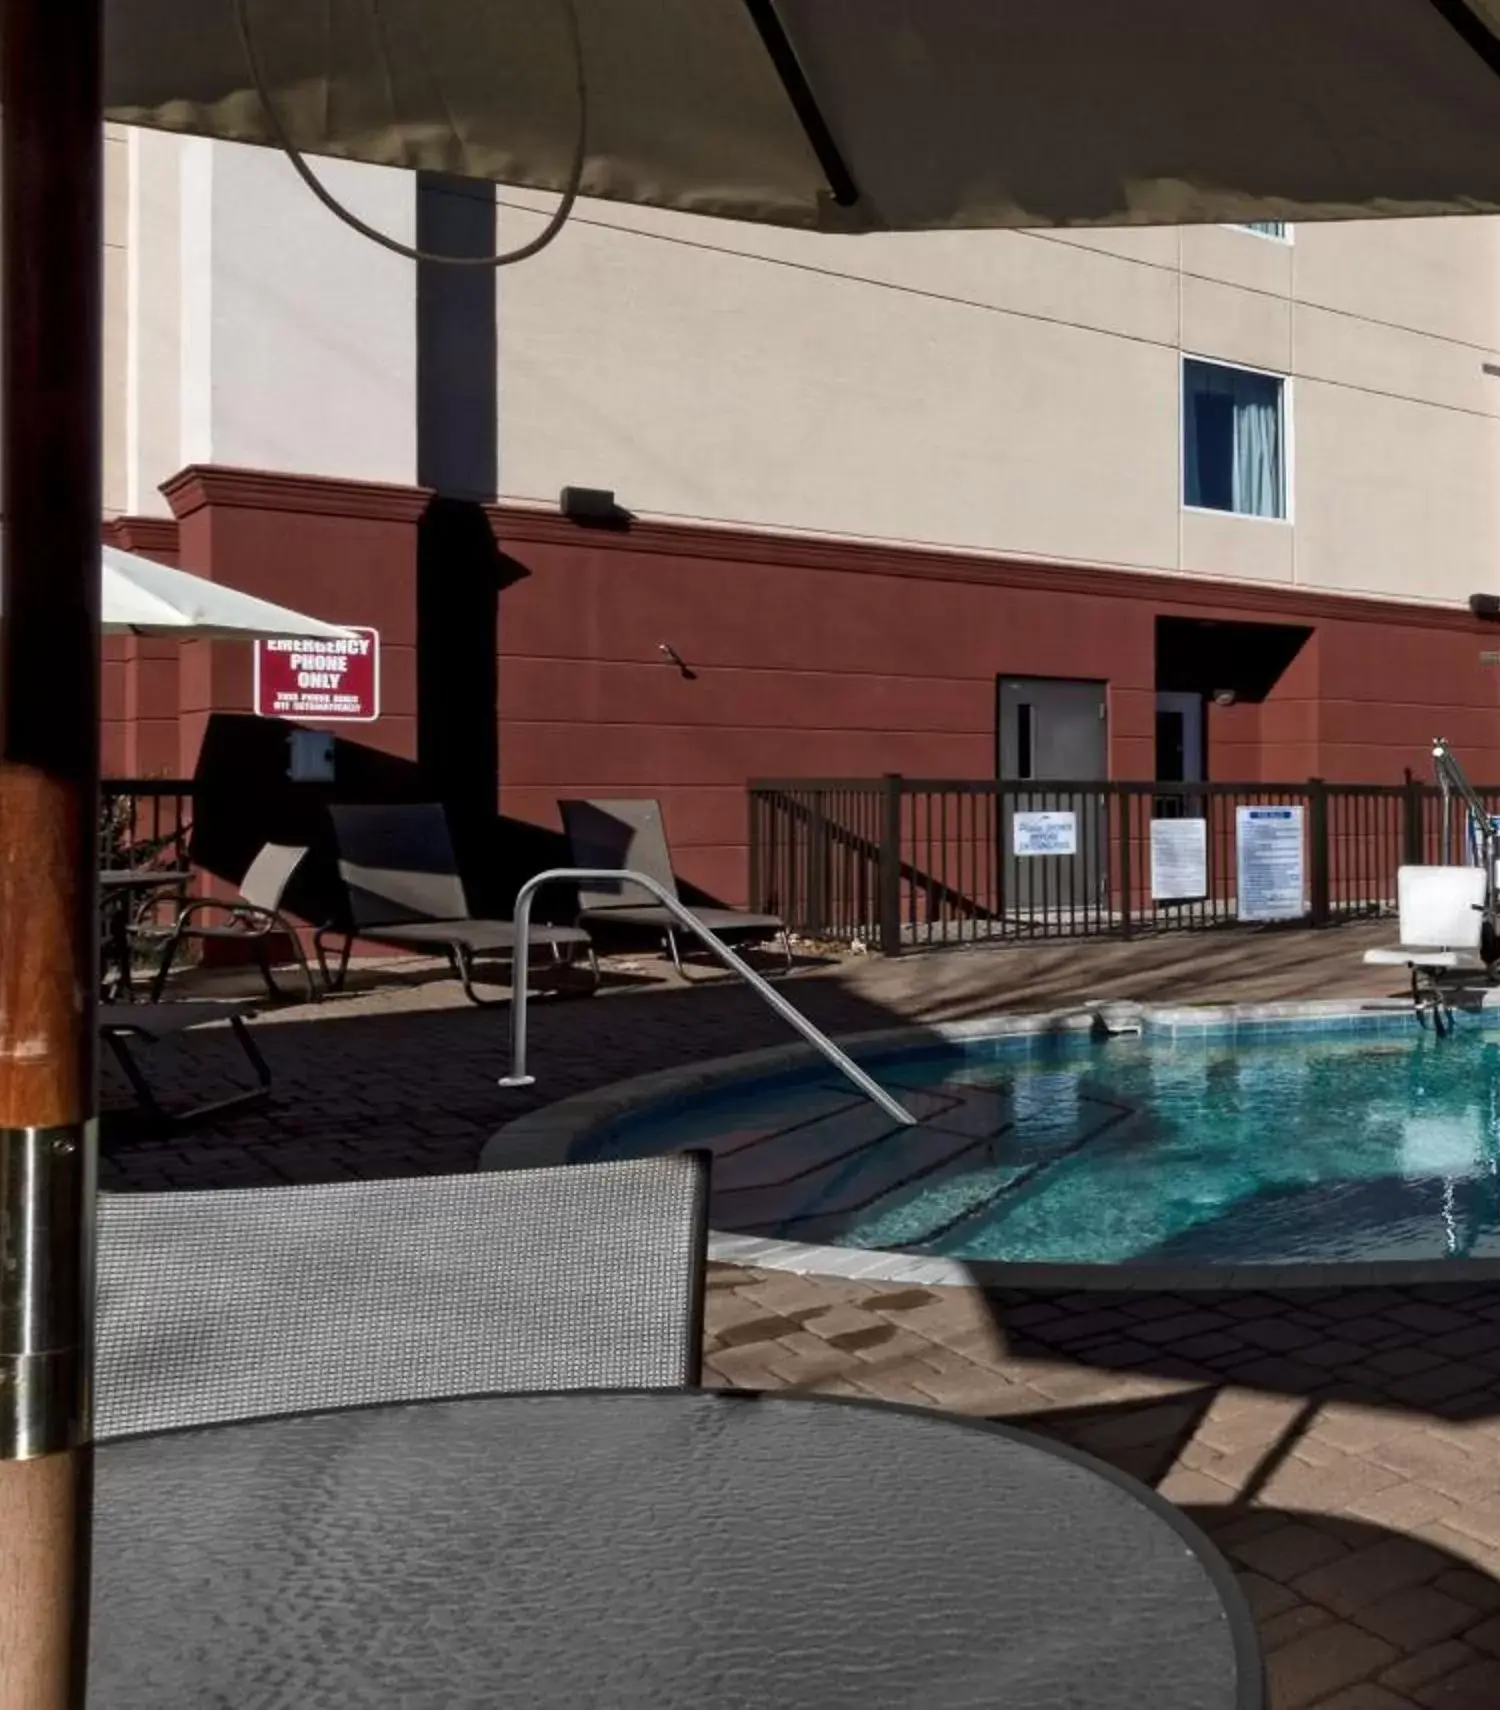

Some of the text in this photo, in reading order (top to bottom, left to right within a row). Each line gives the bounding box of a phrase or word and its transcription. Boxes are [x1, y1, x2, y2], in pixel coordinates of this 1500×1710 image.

[267, 639, 369, 655] EMERGENCY
[290, 653, 348, 671] PHONE
[297, 671, 340, 689] ONLY
